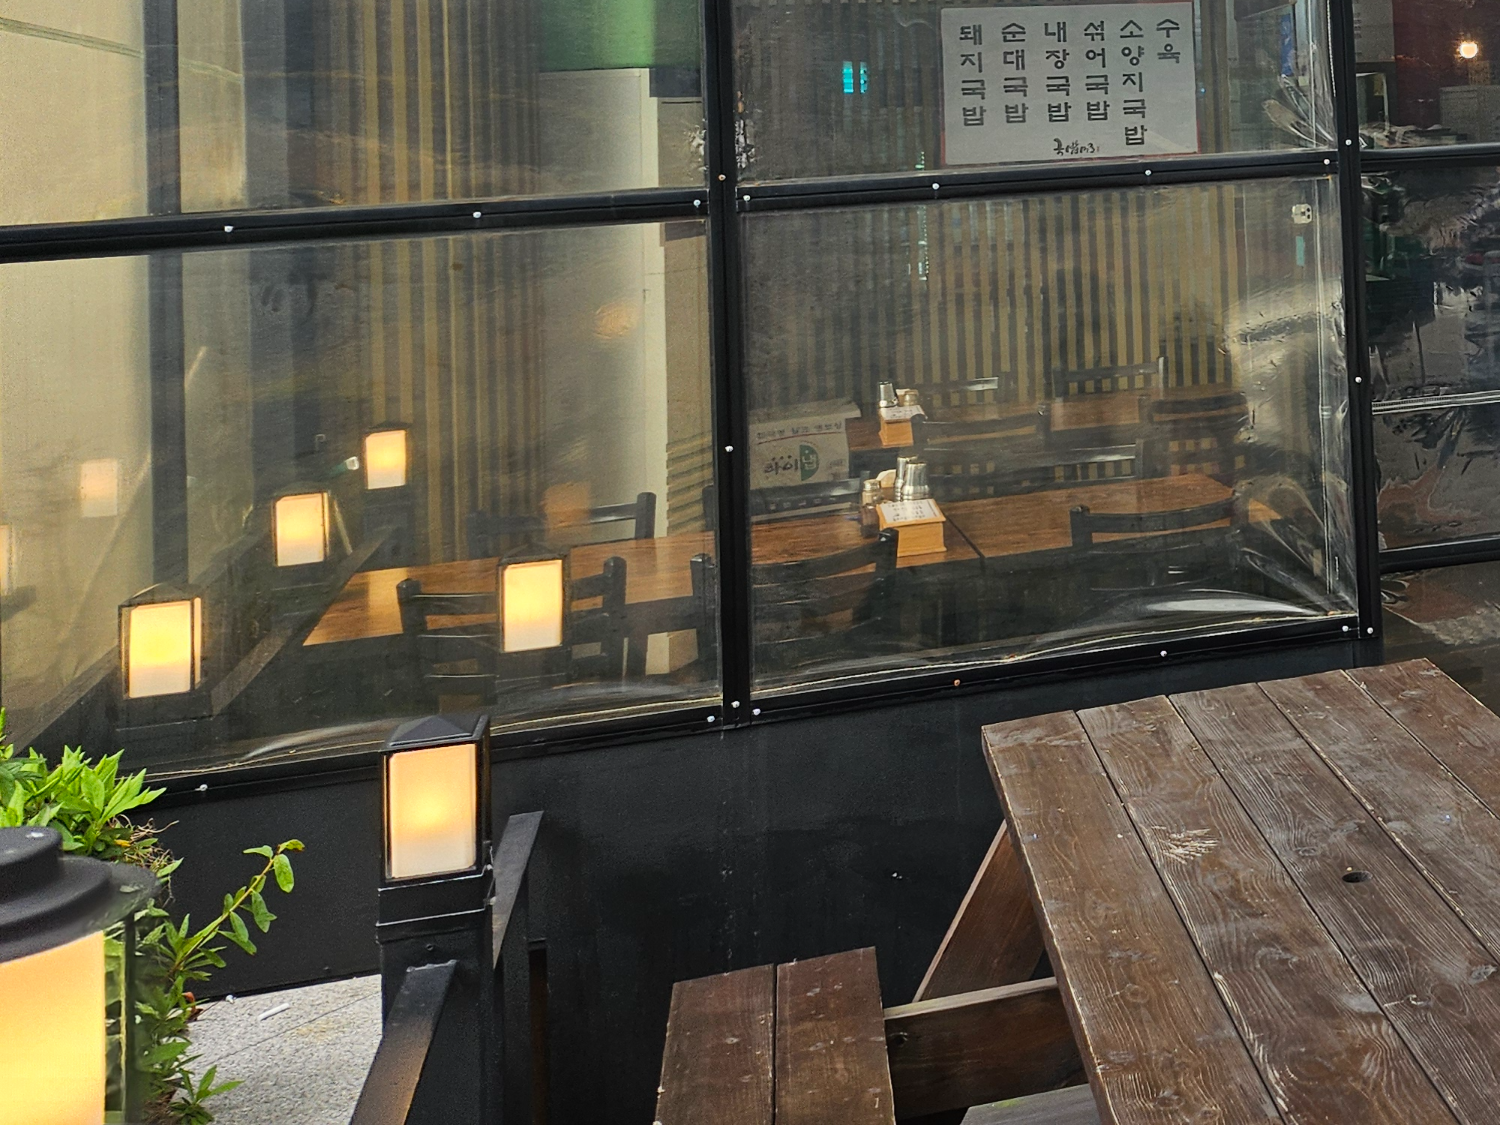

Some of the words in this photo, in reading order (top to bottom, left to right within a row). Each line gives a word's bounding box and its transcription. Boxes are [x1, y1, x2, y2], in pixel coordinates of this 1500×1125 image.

[958, 23, 987, 126] 돼지국밥
[1001, 22, 1029, 124] 순대국밥
[1043, 20, 1072, 123] 내장국밥
[1083, 20, 1110, 122] 섞어국밥
[1119, 18, 1148, 146] 소양지국밥
[1156, 18, 1181, 64] 수육
